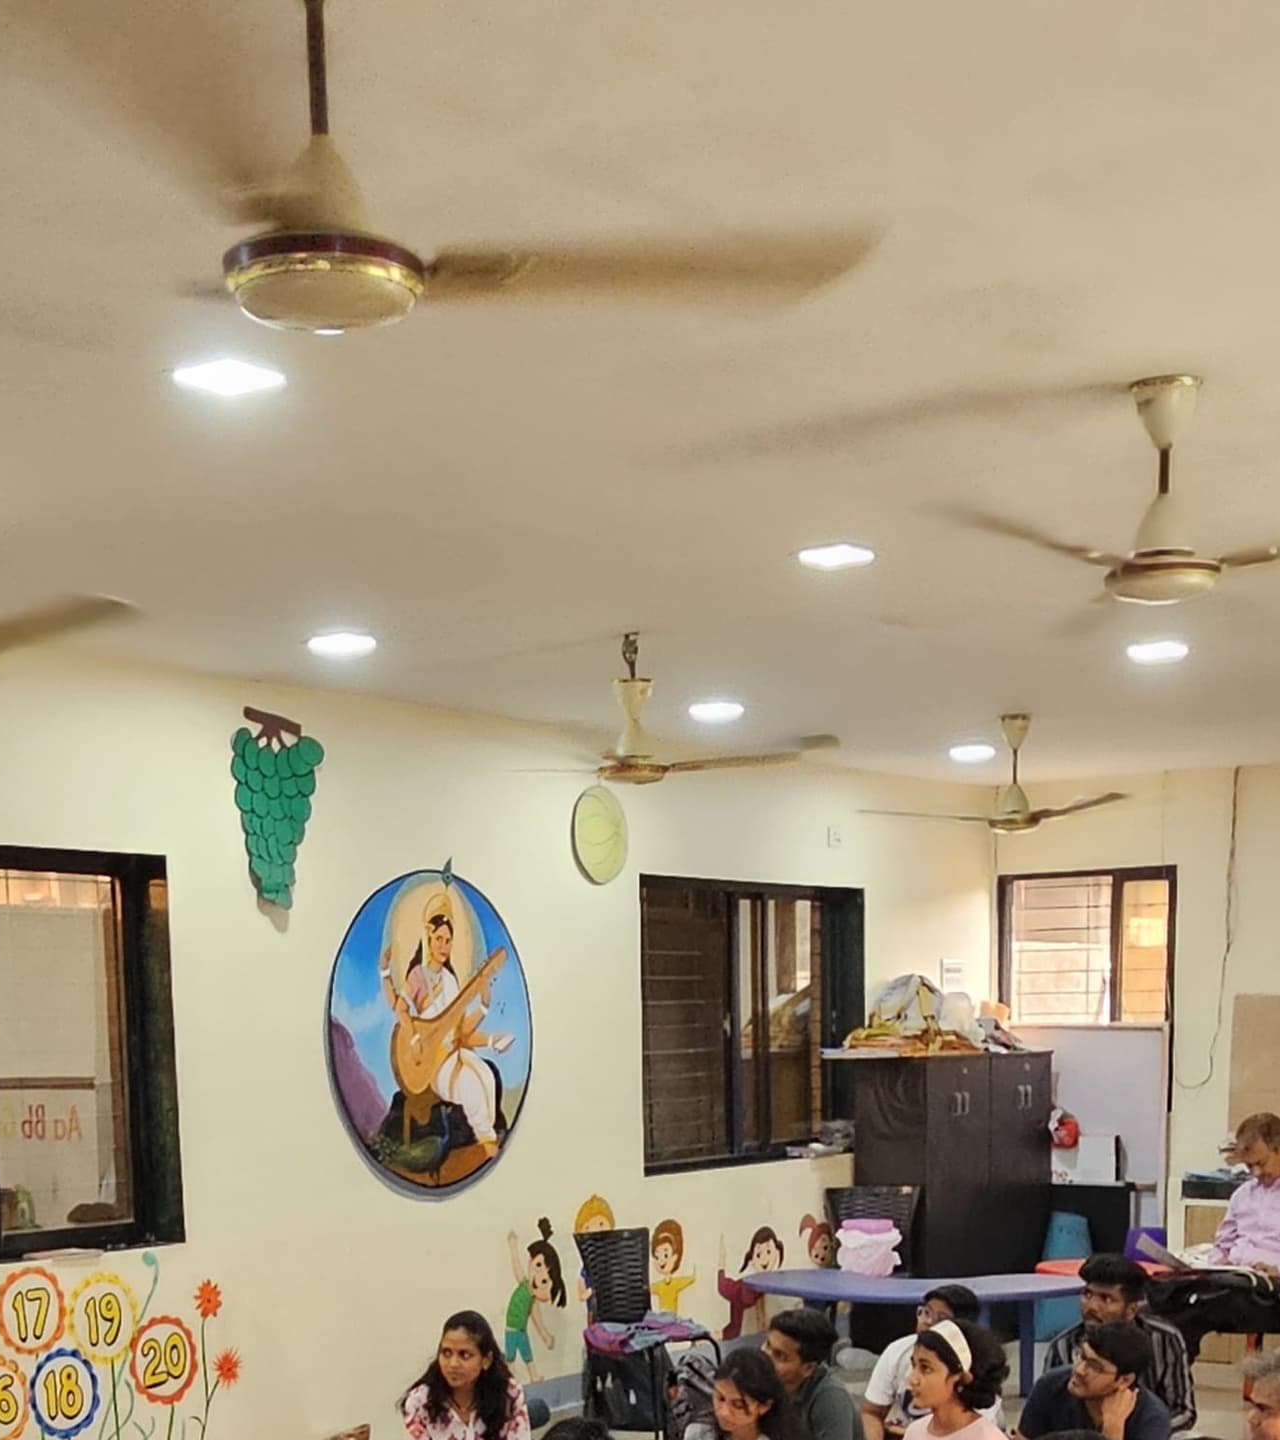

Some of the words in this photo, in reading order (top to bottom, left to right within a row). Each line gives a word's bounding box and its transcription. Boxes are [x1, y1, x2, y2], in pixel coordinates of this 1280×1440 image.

[12, 1287, 51, 1342] 17
[84, 1292, 122, 1347] 19
[141, 1332, 186, 1389] 20
[43, 1364, 84, 1421] 18
